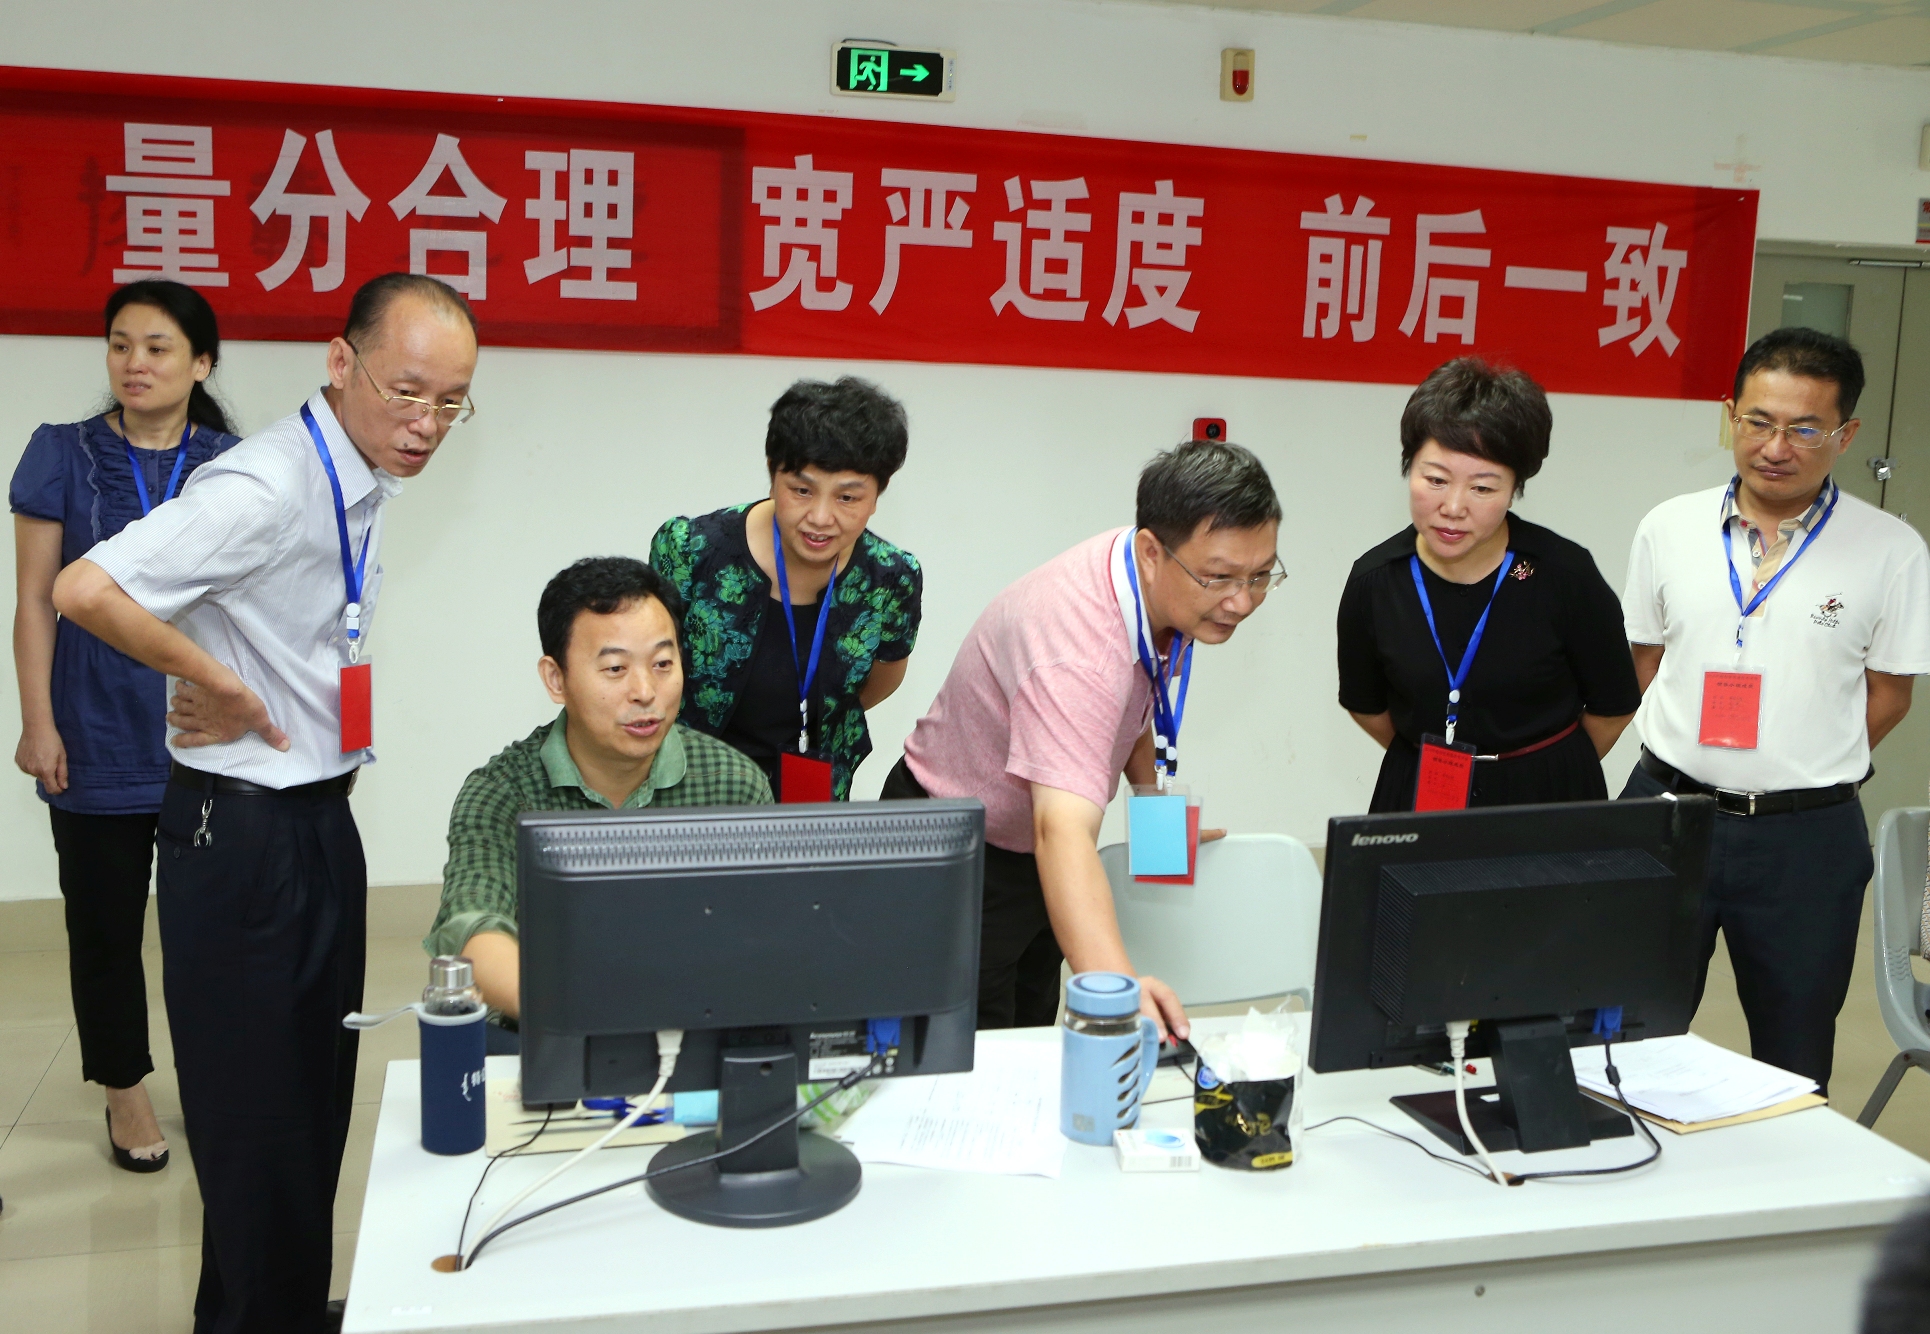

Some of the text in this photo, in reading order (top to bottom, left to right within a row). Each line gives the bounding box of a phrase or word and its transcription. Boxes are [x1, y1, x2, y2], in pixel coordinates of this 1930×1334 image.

[106, 122, 638, 301] 量分合理
[749, 154, 1206, 333] 宽严适度
[1299, 193, 1688, 357] 前后一致
[1351, 833, 1419, 847] lenovo
